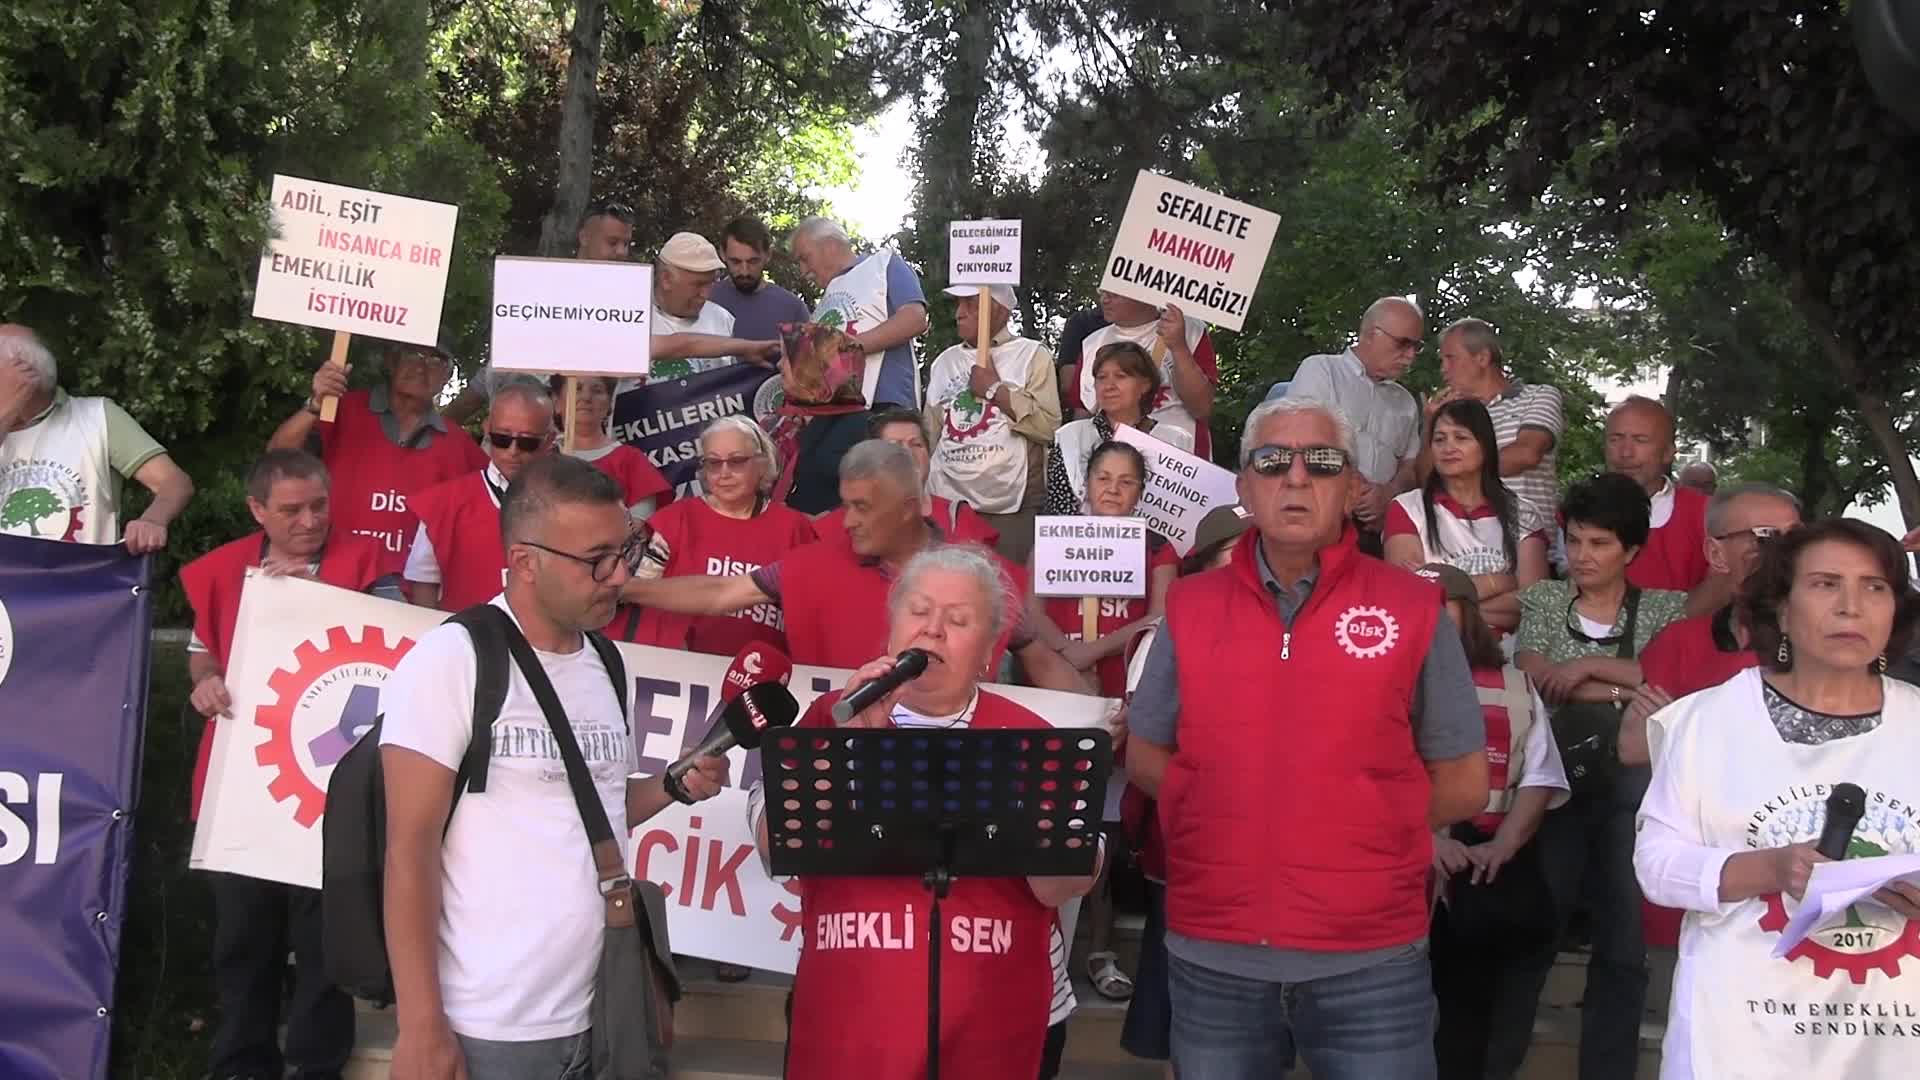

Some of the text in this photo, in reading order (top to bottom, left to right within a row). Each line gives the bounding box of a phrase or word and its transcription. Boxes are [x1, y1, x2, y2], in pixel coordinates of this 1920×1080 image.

[338, 197, 383, 225] EŞİT
[1157, 191, 1251, 239] SEFALETE
[951, 225, 1019, 238] GELECEĞİMİZE
[317, 227, 442, 268] İNSANCA BİR
[968, 243, 1000, 255] SAHİP
[1147, 228, 1235, 273] MAHKUM
[271, 252, 376, 289] EMEKLİLİK
[956, 261, 1013, 275] ÇIKIYORUZ
[1111, 256, 1248, 316] OLMAYACAĞIZ!
[307, 287, 408, 326] İSTİYORUZ
[495, 302, 645, 324] GEÇİNEMİYORUZ
[1158, 453, 1199, 479] VERGİ
[1140, 491, 1187, 518] DALET
[1038, 522, 1142, 540] EKMEĞİMİZE
[1064, 547, 1115, 561] SAHİP
[1045, 569, 1135, 585] ÇIKIYORUZ
[816, 903, 914, 950] EMEKLİ
[951, 915, 1012, 953] SEN
[1833, 932, 1874, 948] 2017
[1746, 999, 1916, 1017] TÜM EMEKLİL
